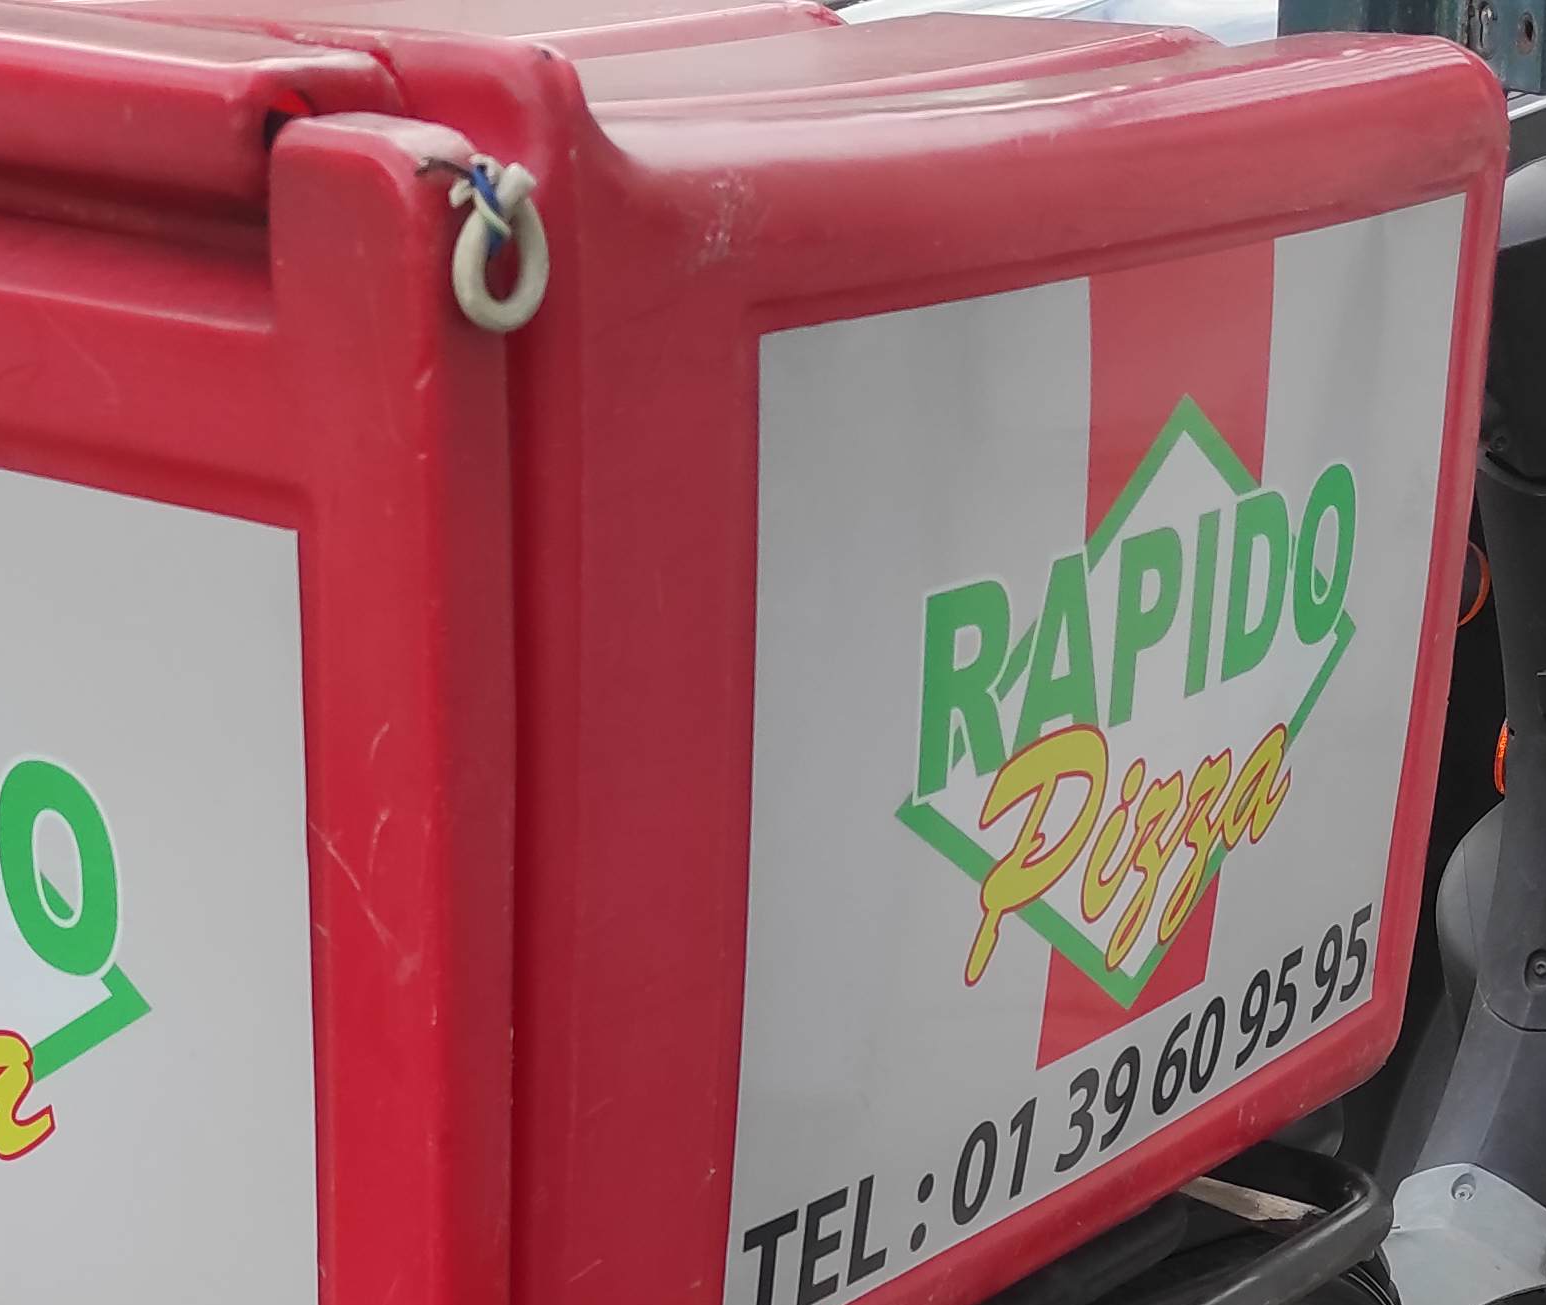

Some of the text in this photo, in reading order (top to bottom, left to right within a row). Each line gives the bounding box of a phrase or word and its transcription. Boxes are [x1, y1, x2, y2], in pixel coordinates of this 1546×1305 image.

[917, 461, 1357, 796] RAPIDO
[964, 724, 1292, 987] Pizza
[951, 1097, 1039, 1227] 01
[1053, 1044, 1142, 1174] 39
[1150, 996, 1227, 1117] 60
[1233, 945, 1305, 1072] 95
[1309, 902, 1374, 1025] 95
